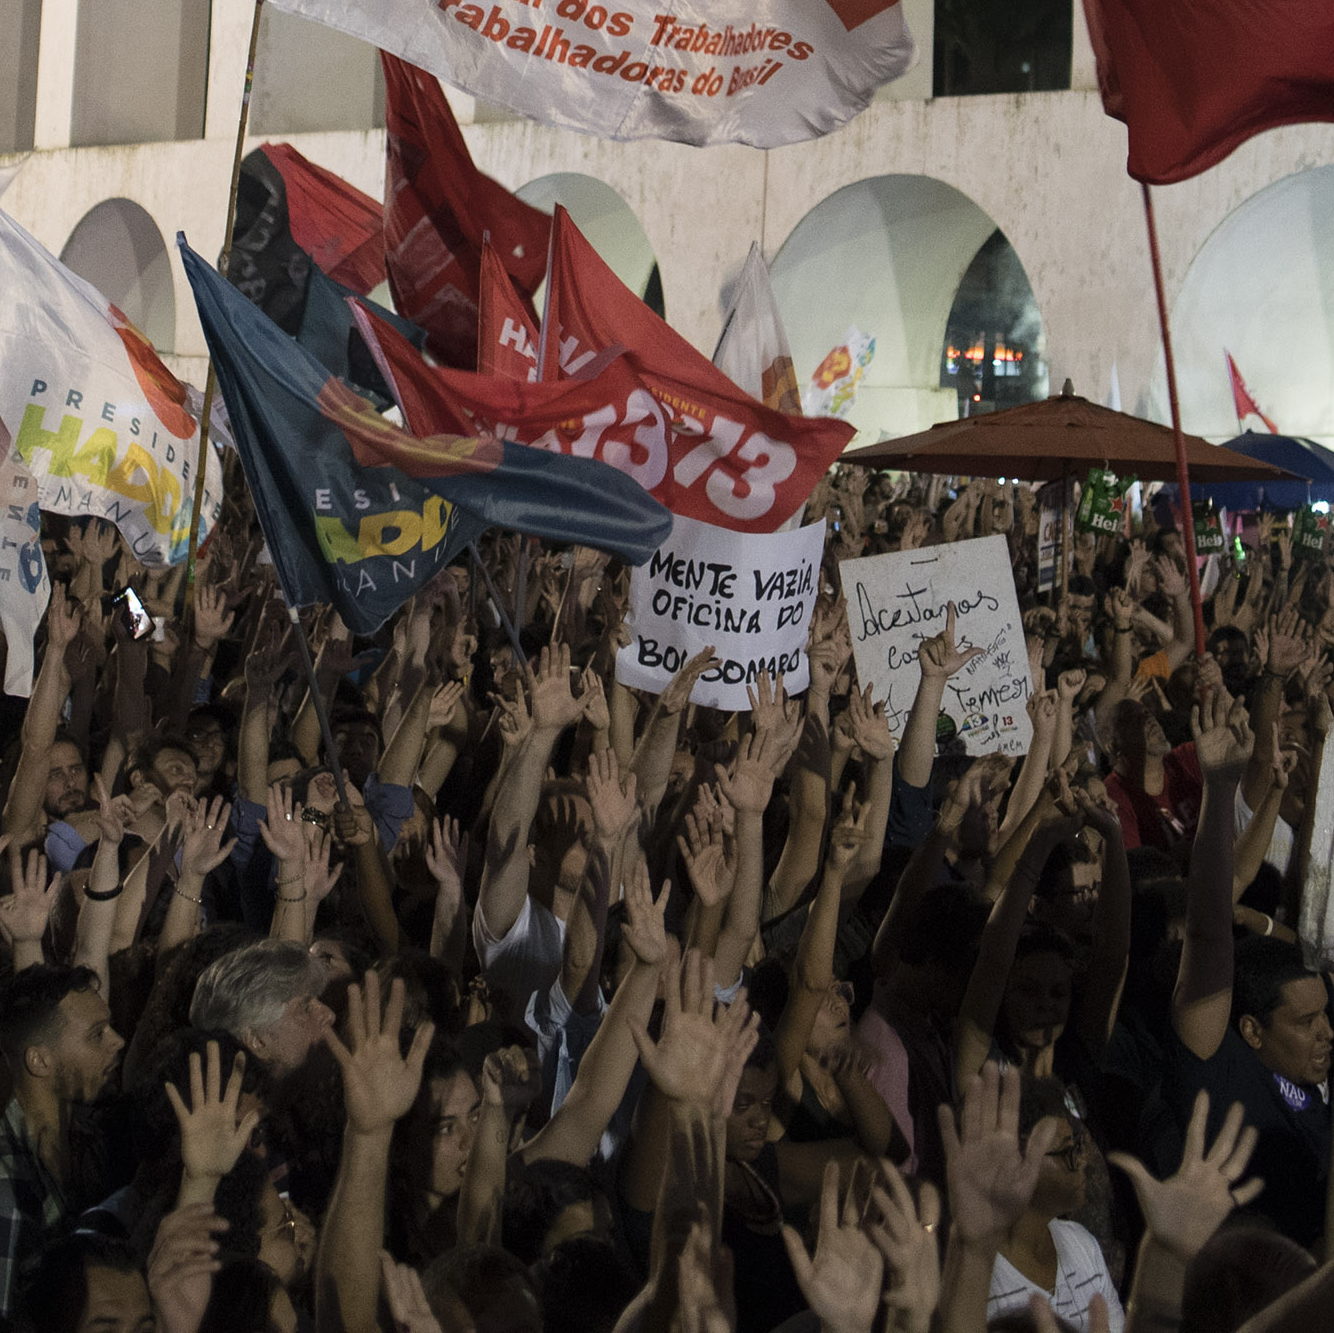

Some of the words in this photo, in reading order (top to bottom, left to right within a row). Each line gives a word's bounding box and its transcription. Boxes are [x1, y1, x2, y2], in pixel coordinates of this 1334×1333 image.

[652, 15, 815, 61] Trabalhadores
[692, 68, 723, 97] do
[673, 415, 798, 520] 13
[650, 549, 737, 598] MENTE
[753, 558, 814, 601] VAZIA,
[653, 589, 761, 633] OFICINA
[777, 601, 804, 631] DO
[1002, 716, 1013, 726] 13
